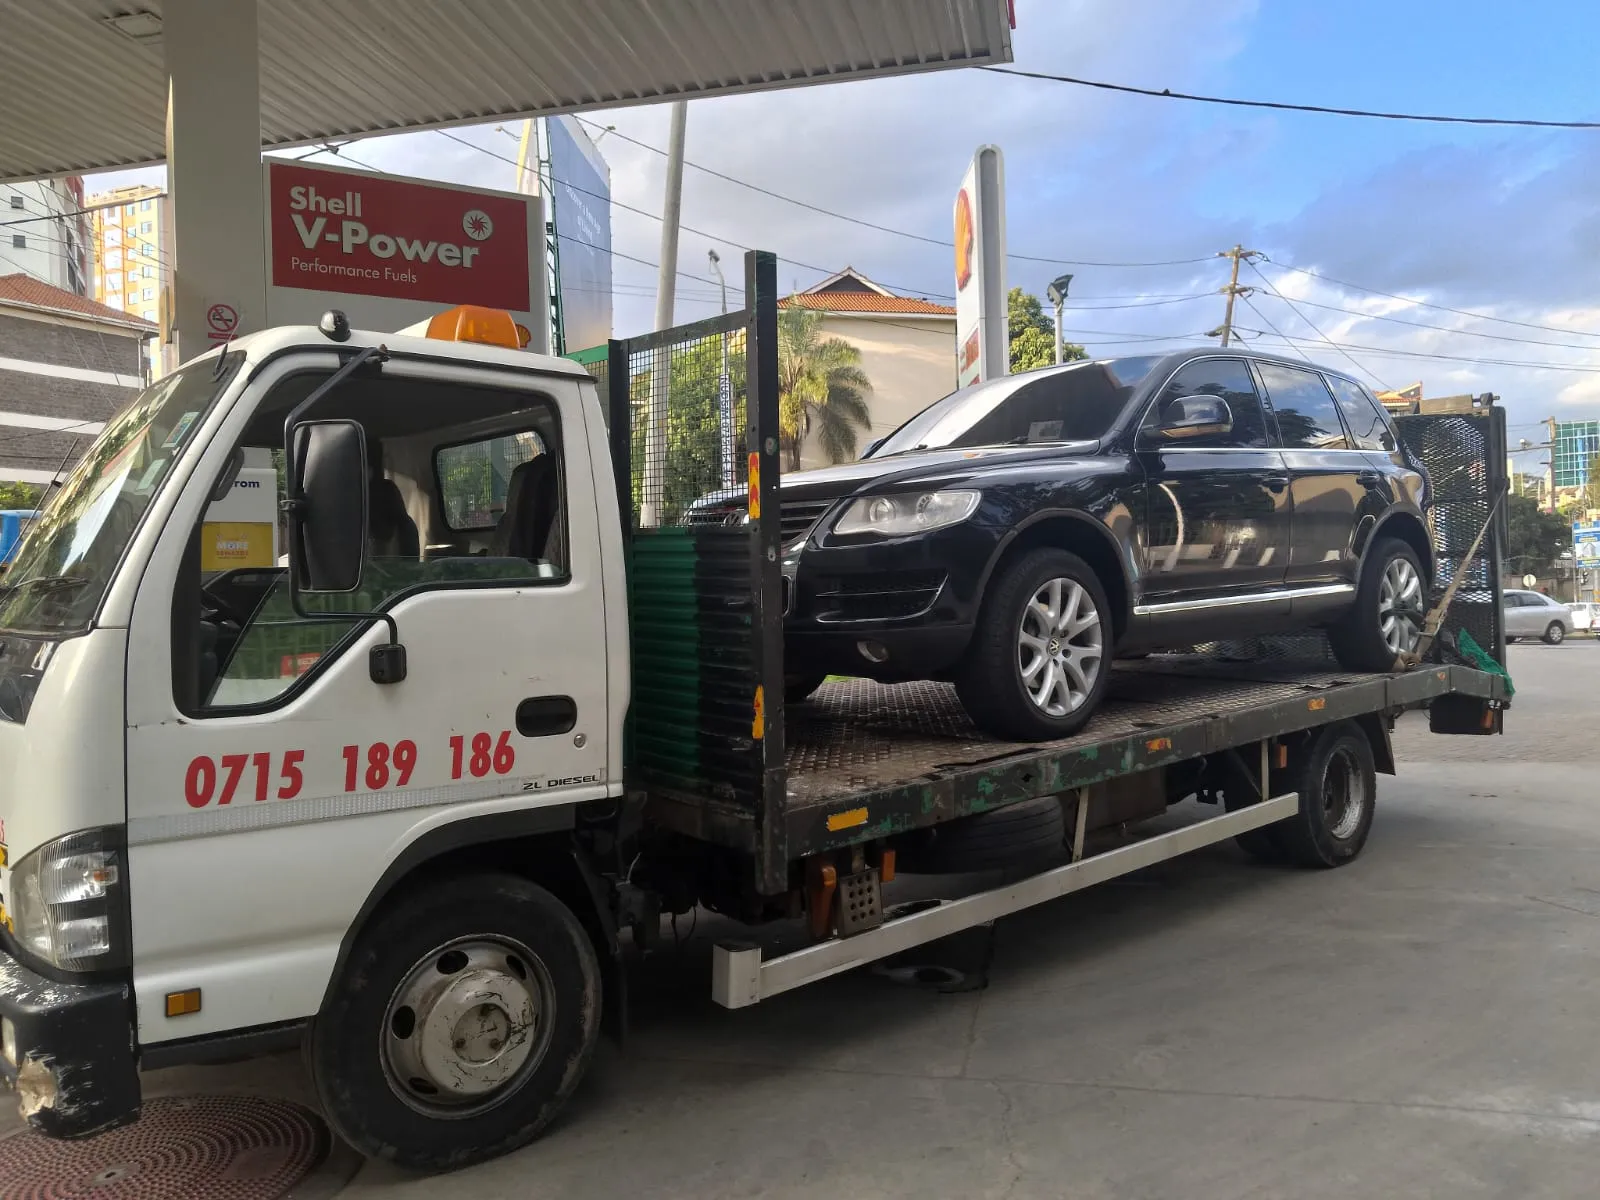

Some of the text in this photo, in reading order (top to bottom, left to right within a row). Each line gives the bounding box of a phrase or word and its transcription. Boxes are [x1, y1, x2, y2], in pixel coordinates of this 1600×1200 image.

[290, 185, 362, 217] Shell
[290, 213, 480, 268] V-Power
[291, 256, 417, 284] Performance Fuels
[184, 730, 515, 808] 0715 189 186
[547, 775, 600, 788] DIESEL
